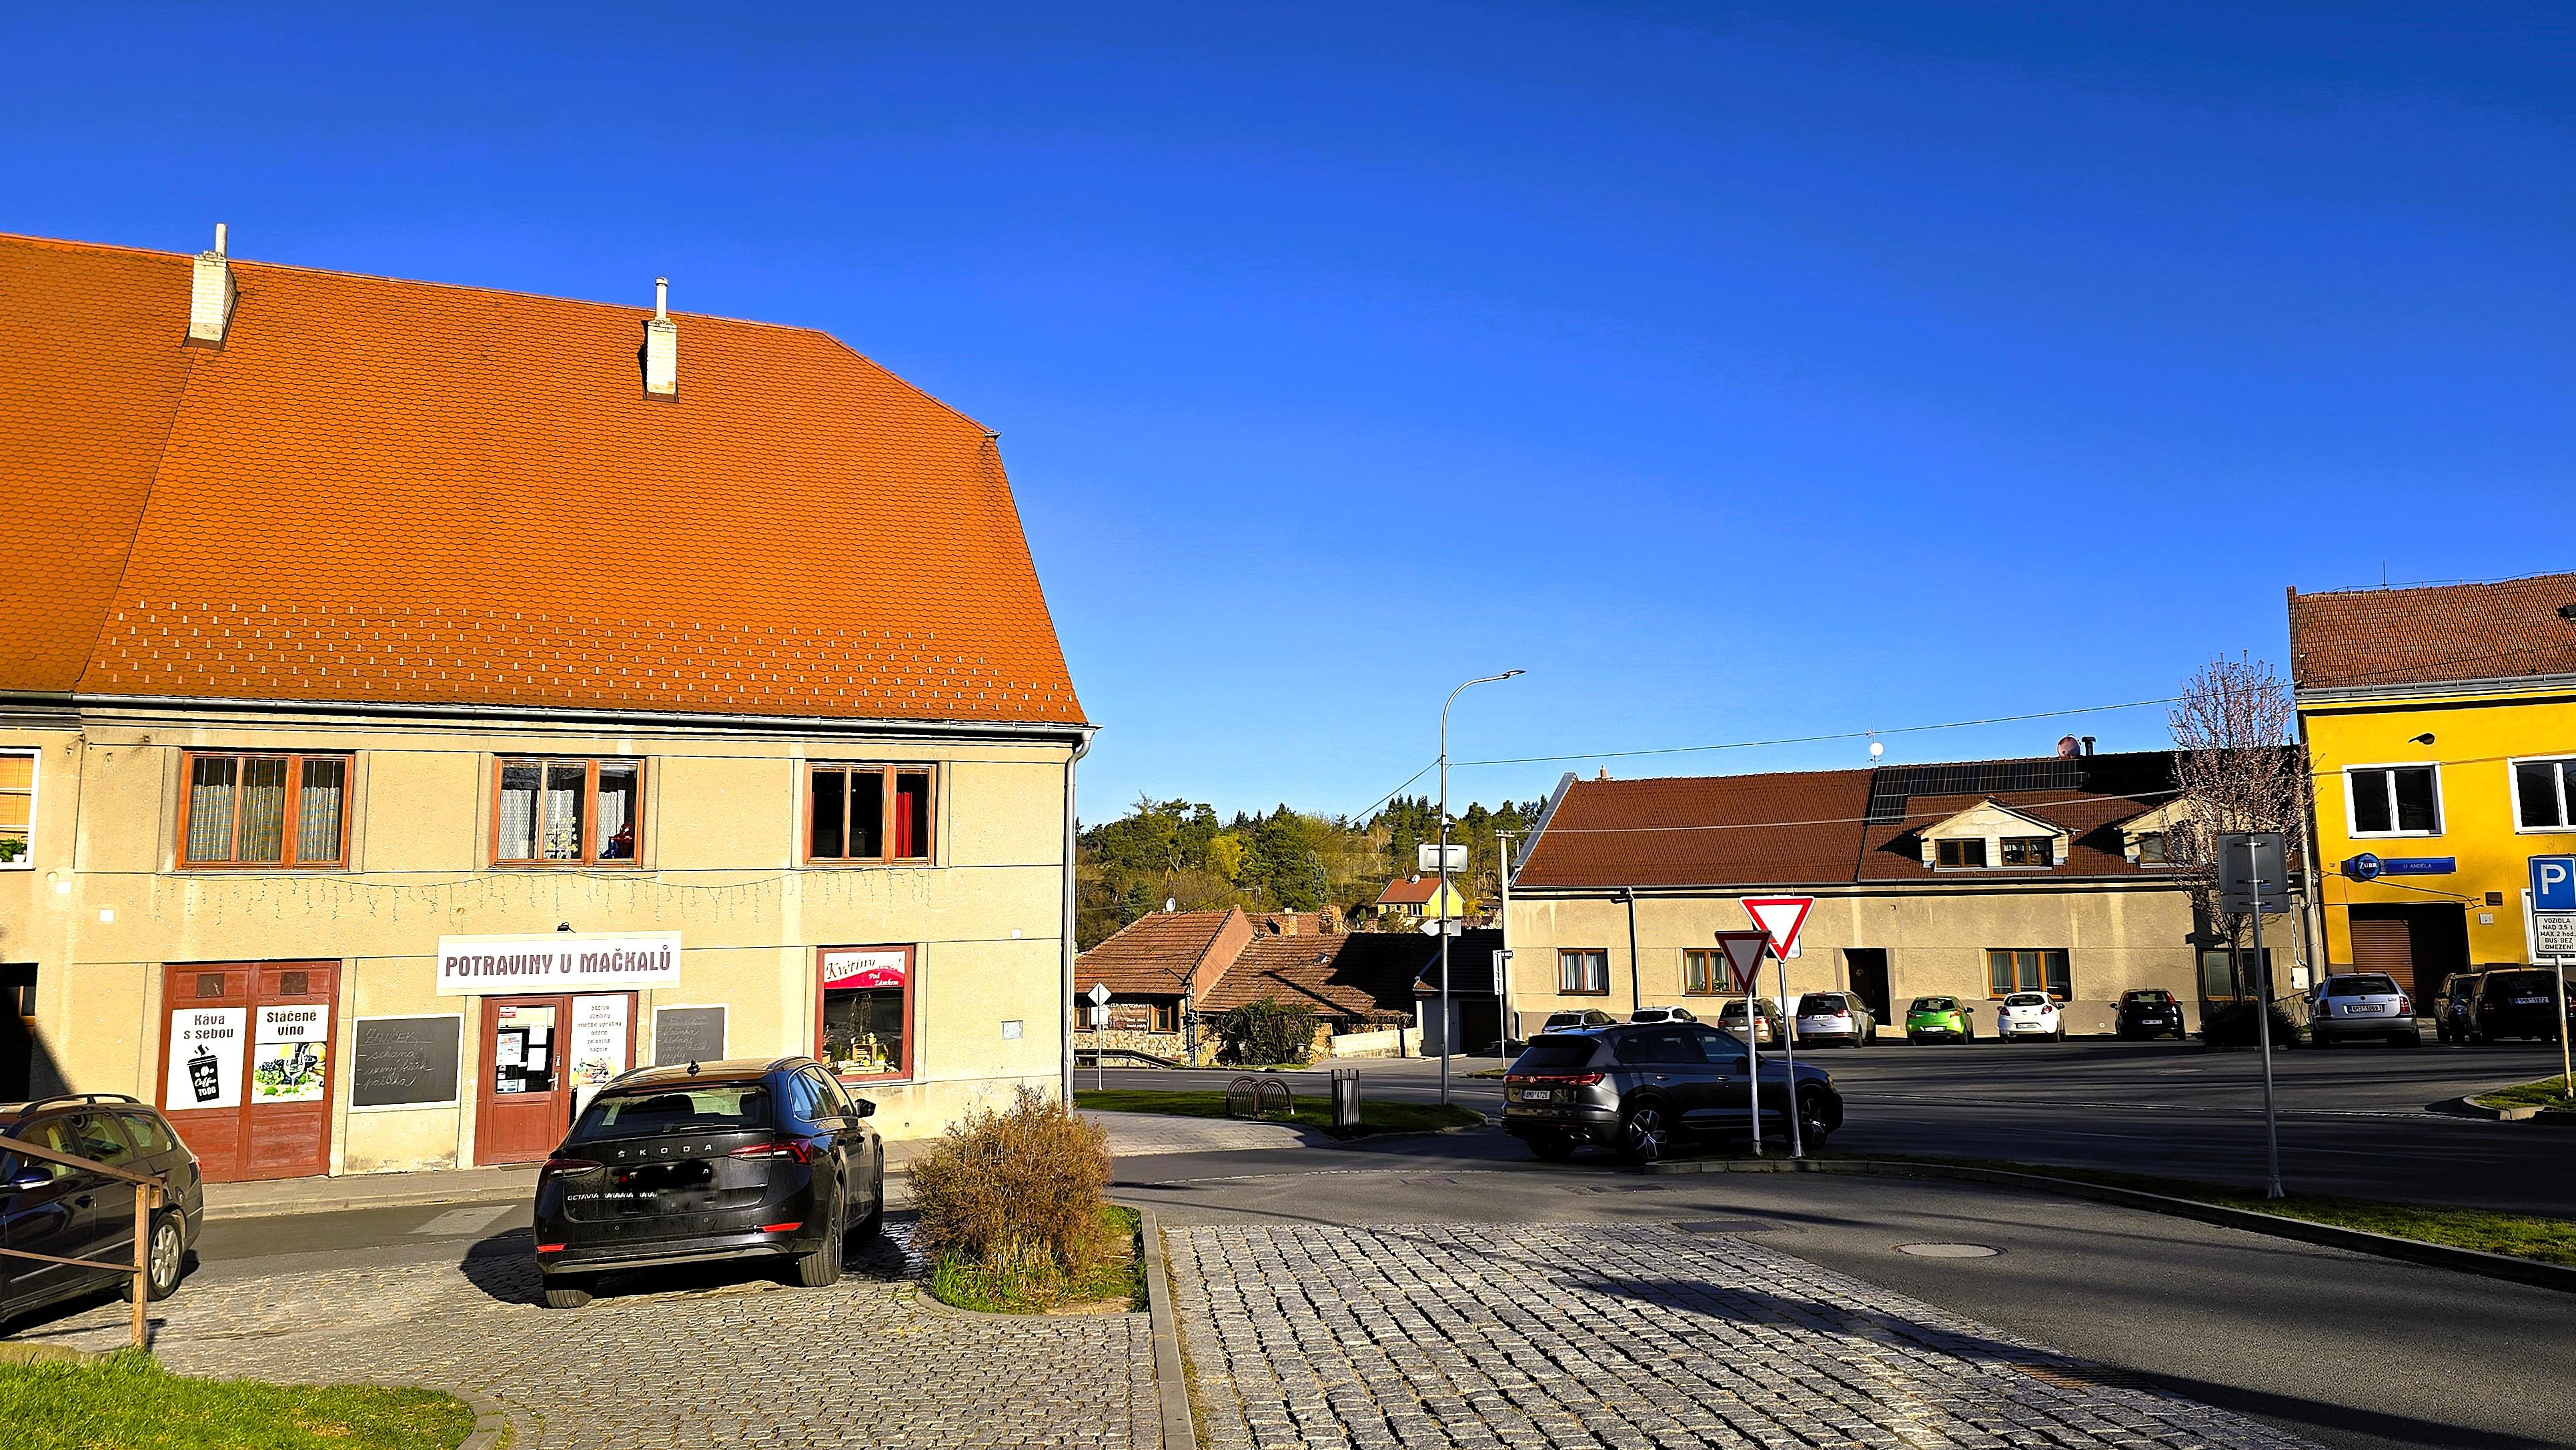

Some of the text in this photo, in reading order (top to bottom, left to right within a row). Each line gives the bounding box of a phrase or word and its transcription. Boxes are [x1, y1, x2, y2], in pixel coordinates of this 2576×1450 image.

[2540, 864, 2567, 895] P
[446, 944, 671, 976] POTRAVINY U MAČKALŮ
[195, 1014, 225, 1025] Káva
[267, 1010, 316, 1022] Stáčené
[183, 1028, 233, 1039] s sebou
[278, 1024, 303, 1035] víno
[567, 1193, 599, 1201] OCTAVIA
